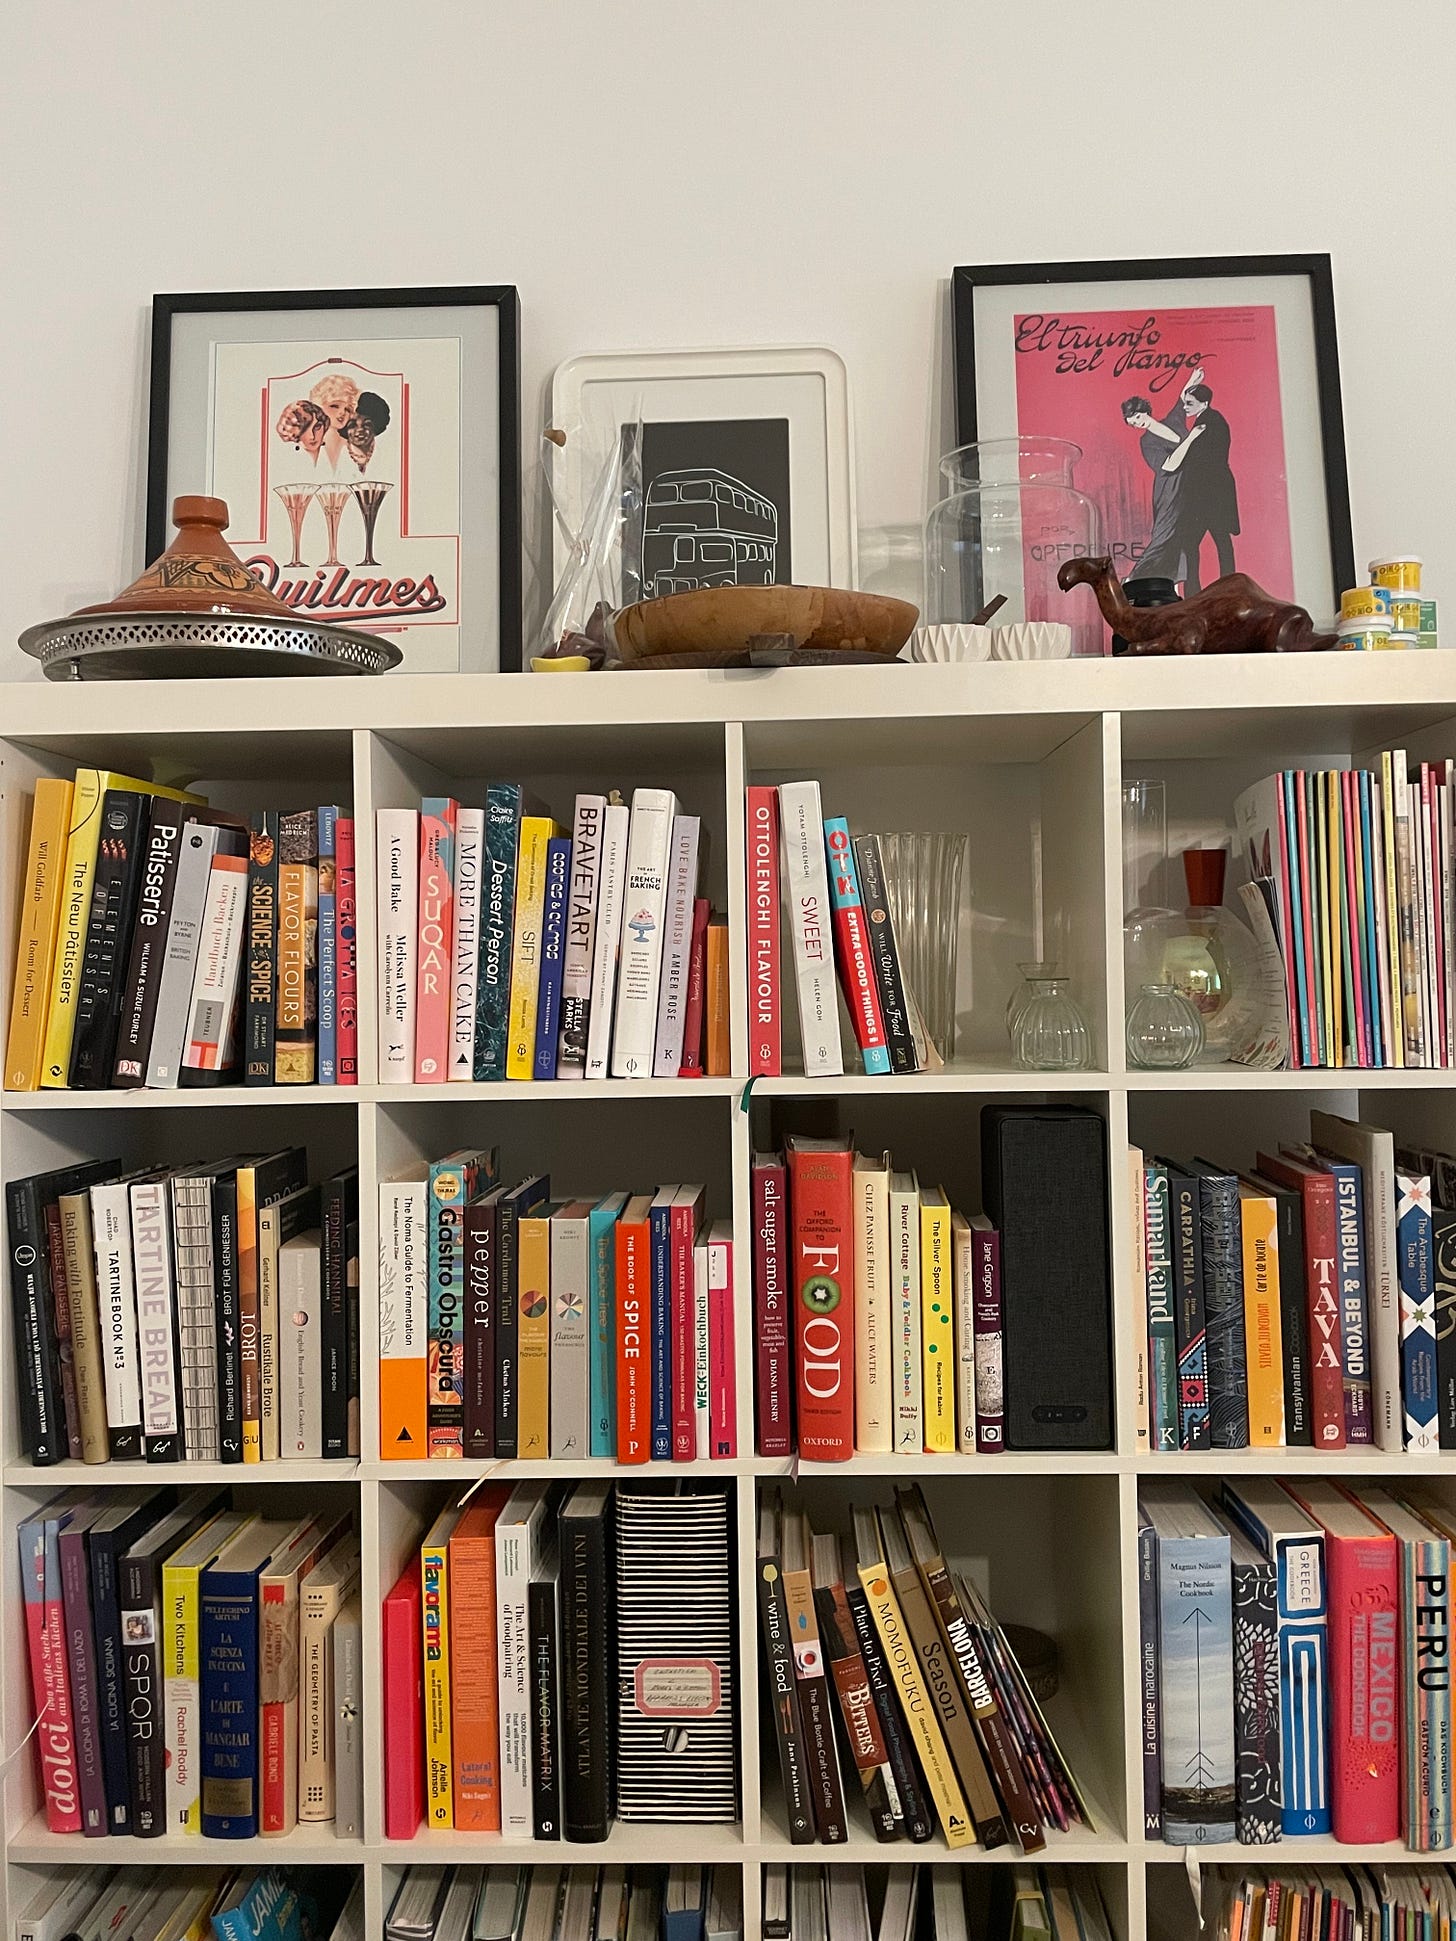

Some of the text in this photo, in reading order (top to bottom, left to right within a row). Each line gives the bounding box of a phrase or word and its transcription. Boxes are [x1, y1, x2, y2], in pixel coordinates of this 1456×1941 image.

[1015, 314, 1162, 377] El triunfo
[1054, 348, 1217, 393] del tango
[243, 554, 447, 617] Quilmes
[34, 841, 48, 903] Will Goldfarb
[141, 823, 177, 927] Patisserie
[390, 834, 401, 913] A Good Bake
[458, 843, 478, 908] MORE
[570, 807, 598, 952] BRAVETART
[629, 882, 661, 891] BAKING
[630, 875, 662, 884] FRENCH
[800, 831, 809, 879] OTTOLENGHI
[828, 830, 856, 896] OTK
[60, 861, 87, 1005] The New Pâtissiers
[97, 880, 121, 995] ELEMENTS
[204, 883, 229, 988] Handbuch Backen
[250, 884, 274, 949] SCIENCE
[283, 872, 300, 1024] FLAVOR FLOURS
[420, 874, 445, 995] SUQAR
[456, 913, 475, 977] THAN
[486, 860, 508, 986] Dessert Person
[521, 930, 535, 966] SIFT
[756, 806, 771, 1024] OTTOLENGHI FLAVOUR
[800, 896, 823, 961] SWEET
[79, 890, 107, 1020] OF DESSERT
[250, 959, 272, 1004] SPICE
[320, 909, 334, 1029] The Perfect Scoop
[395, 934, 406, 1023] Melissa Weller
[130, 942, 150, 1046] WILLIAM & SUZUE CURLEY
[454, 982, 473, 1044] CAKE
[564, 998, 573, 1030] PARKS
[574, 997, 583, 1032] STELLA
[760, 1210, 777, 1253] sugar
[765, 1180, 779, 1208] salt
[219, 1214, 231, 1316] BROT FÜR GENIESSER
[438, 1207, 457, 1288] Gastro
[501, 1206, 511, 1327] The Cardamom Trail
[865, 1183, 876, 1291] CHEZ PANISSE FRUIT
[931, 1220, 940, 1296] The Silver Spoon
[982, 1242, 992, 1262] Jane
[1144, 1175, 1174, 1325] Samarkand
[1179, 1190, 1197, 1288] CARPATHIA
[1407, 1241, 1416, 1269] Table
[1416, 1217, 1428, 1294] The Arabesque
[63, 1211, 87, 1350] Baking with Fortitude
[135, 1186, 173, 1431] TARTINE BREAD
[470, 1228, 491, 1329] pepper
[628, 1282, 635, 1295] OF
[765, 1255, 784, 1310] smoke
[981, 1262, 992, 1298] Grigson
[1313, 1258, 1342, 1368] TAVA
[1337, 1177, 1365, 1377] ISTANBUL & BEYOND
[1381, 1270, 1390, 1309] TÜRKEI
[240, 1311, 257, 1361] BROT
[438, 1291, 458, 1393] Obscura
[555, 1330, 585, 1342] flavour
[624, 1300, 639, 1359] SPICE
[867, 1312, 877, 1386] ALICE WATERS
[224, 1352, 234, 1421] Richard Bertinet
[261, 1333, 273, 1418] Rustikale Brote
[1294, 1357, 1303, 1433] Transylvanian
[802, 1437, 843, 1447] OXFORD
[423, 1555, 444, 1661] flavorama
[1300, 1550, 1310, 1605] GREECE
[174, 1595, 185, 1675] Two Kitchens
[310, 1643, 318, 1657] THE
[502, 1603, 513, 1679] of Foodpairing
[515, 1603, 526, 1694] The Art & Science
[767, 1601, 792, 1693] wine & food
[852, 1604, 885, 1690] Plate to Pixel
[878, 1601, 926, 1714] MOMOFUKU
[947, 1615, 995, 1711] BARCELONA
[1415, 1574, 1448, 1692] PERU
[104, 1636, 120, 1731] LA CUCINA SICILIANA
[129, 1653, 152, 1740] SPQR
[310, 1662, 318, 1712] GEOMETRY
[536, 1634, 552, 1792] THE FLAVOR MATRIX
[923, 1640, 960, 1722] Season
[1144, 1642, 1155, 1756] La cuisine marocaine
[1369, 1610, 1394, 1742] MEXICO
[176, 1706, 187, 1786] Rachel Roddy
[269, 1714, 278, 1784] GABRIELE BONCI
[311, 1713, 318, 1727] OF
[847, 1682, 876, 1757] BITTERS
[42, 1721, 77, 1814] dolci
[430, 1757, 439, 1799] Johnson
[438, 1762, 448, 1793] Arielle
[460, 1762, 492, 1772] Lateral
[460, 1774, 493, 1787] Cooking
[787, 1741, 801, 1809] Jane Parkinson
